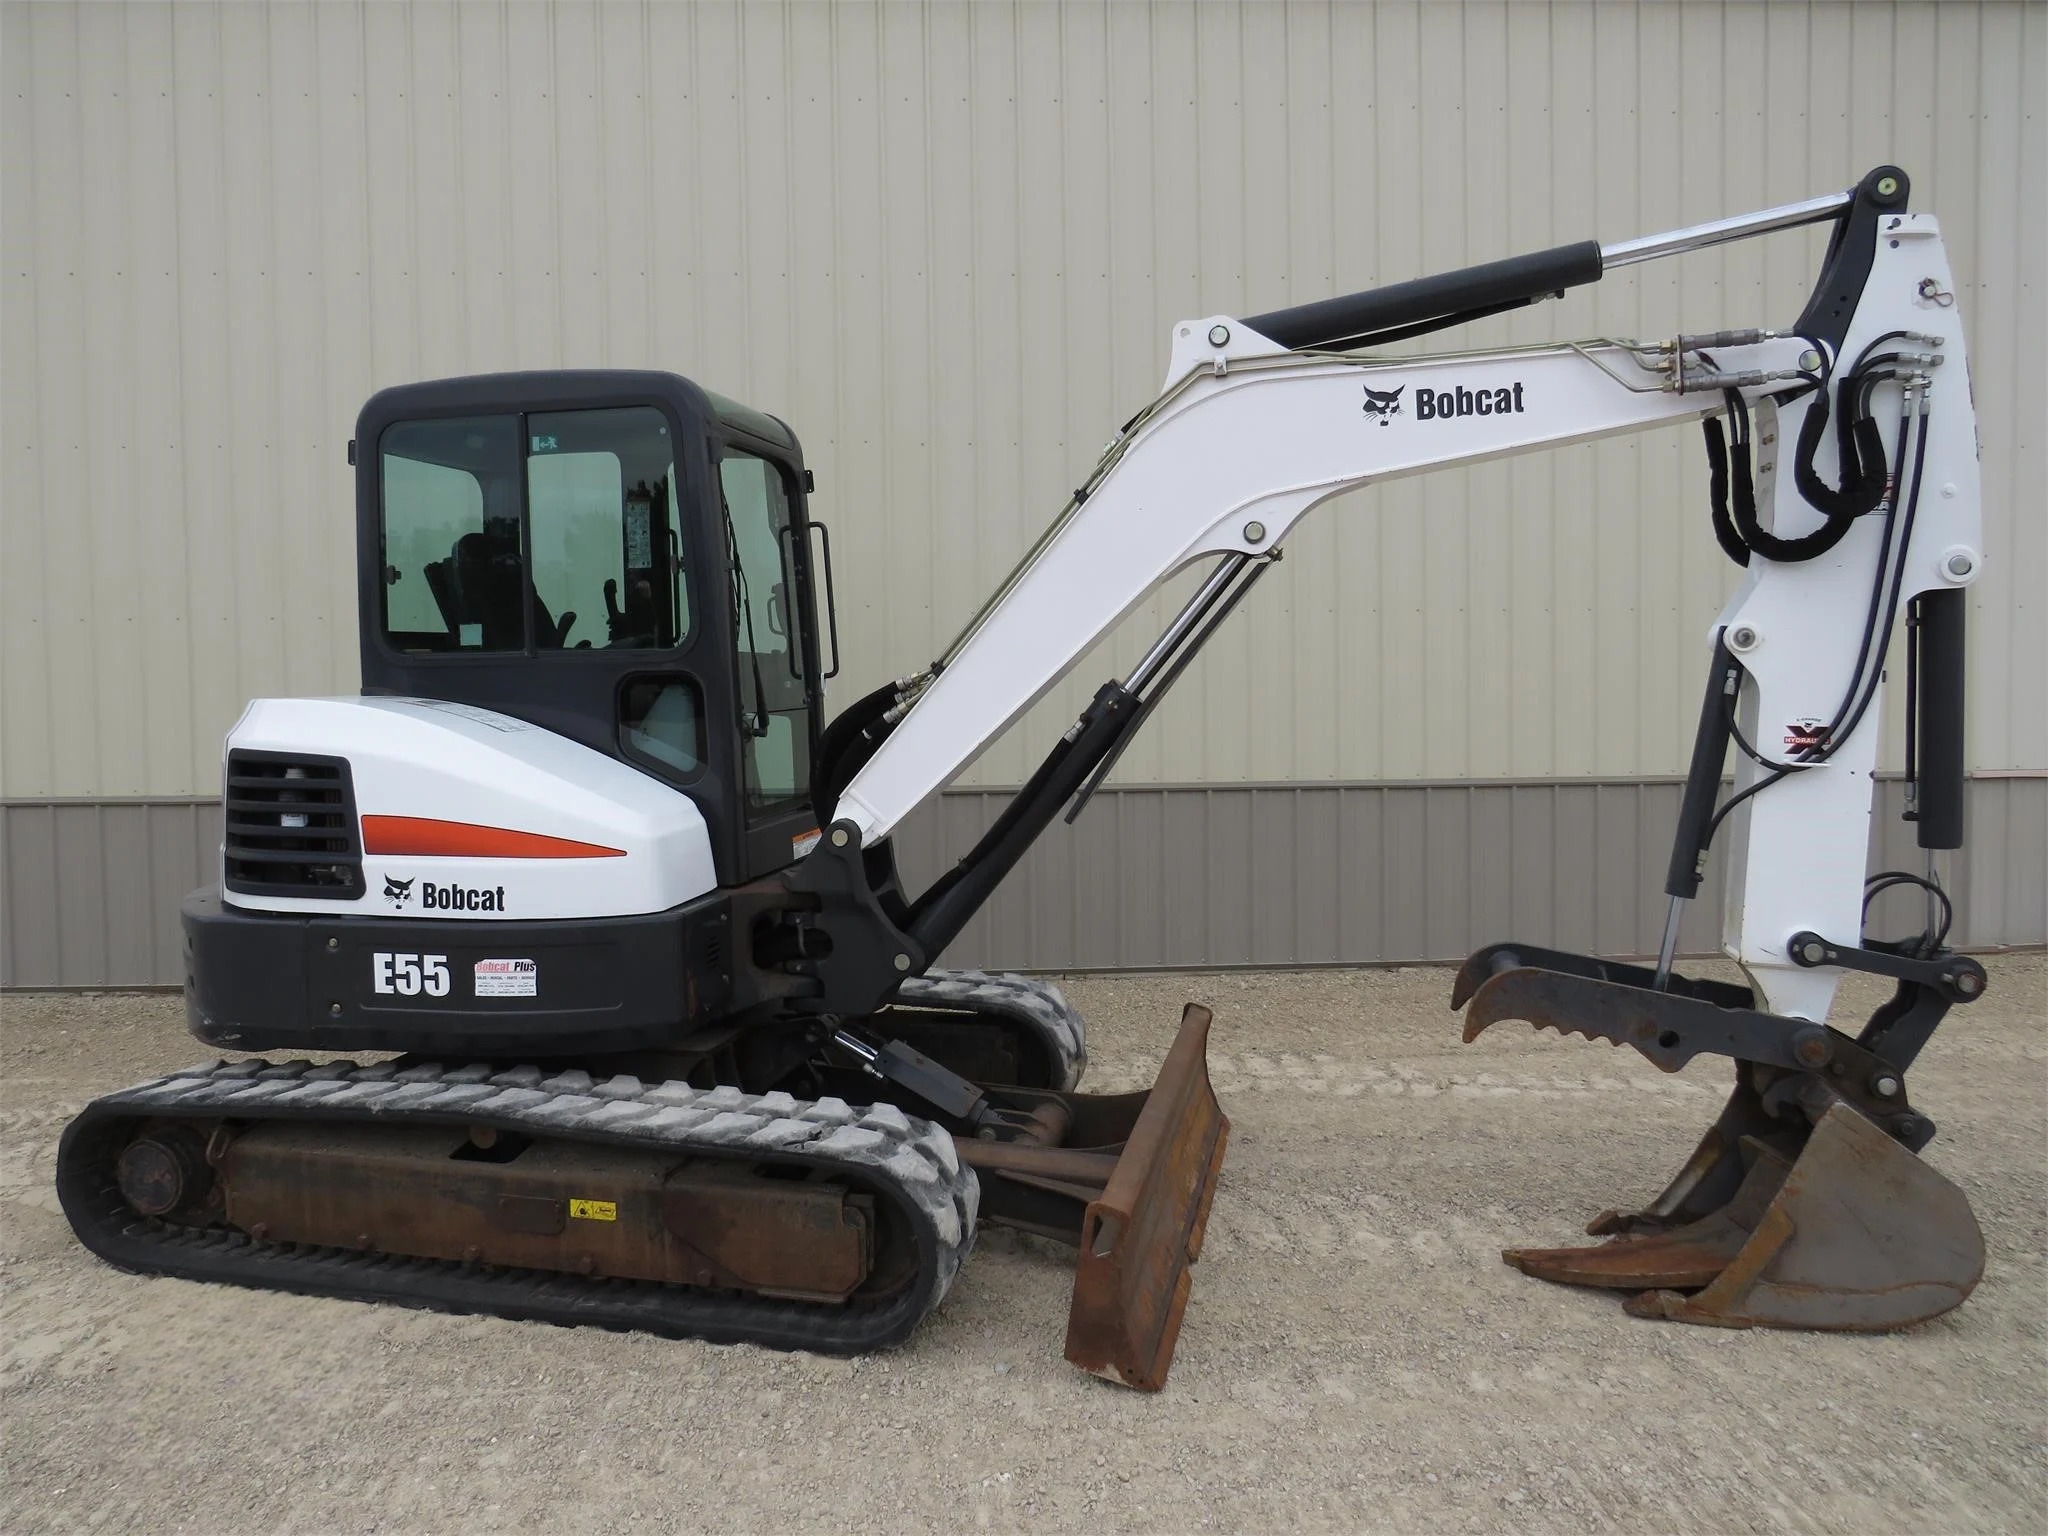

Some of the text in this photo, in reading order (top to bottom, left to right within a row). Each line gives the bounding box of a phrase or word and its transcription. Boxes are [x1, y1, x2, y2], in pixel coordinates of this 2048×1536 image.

[1416, 382, 1524, 421] Bobcat
[423, 882, 505, 911] Bobcat
[373, 952, 451, 997] E55
[513, 961, 536, 972] Plus
